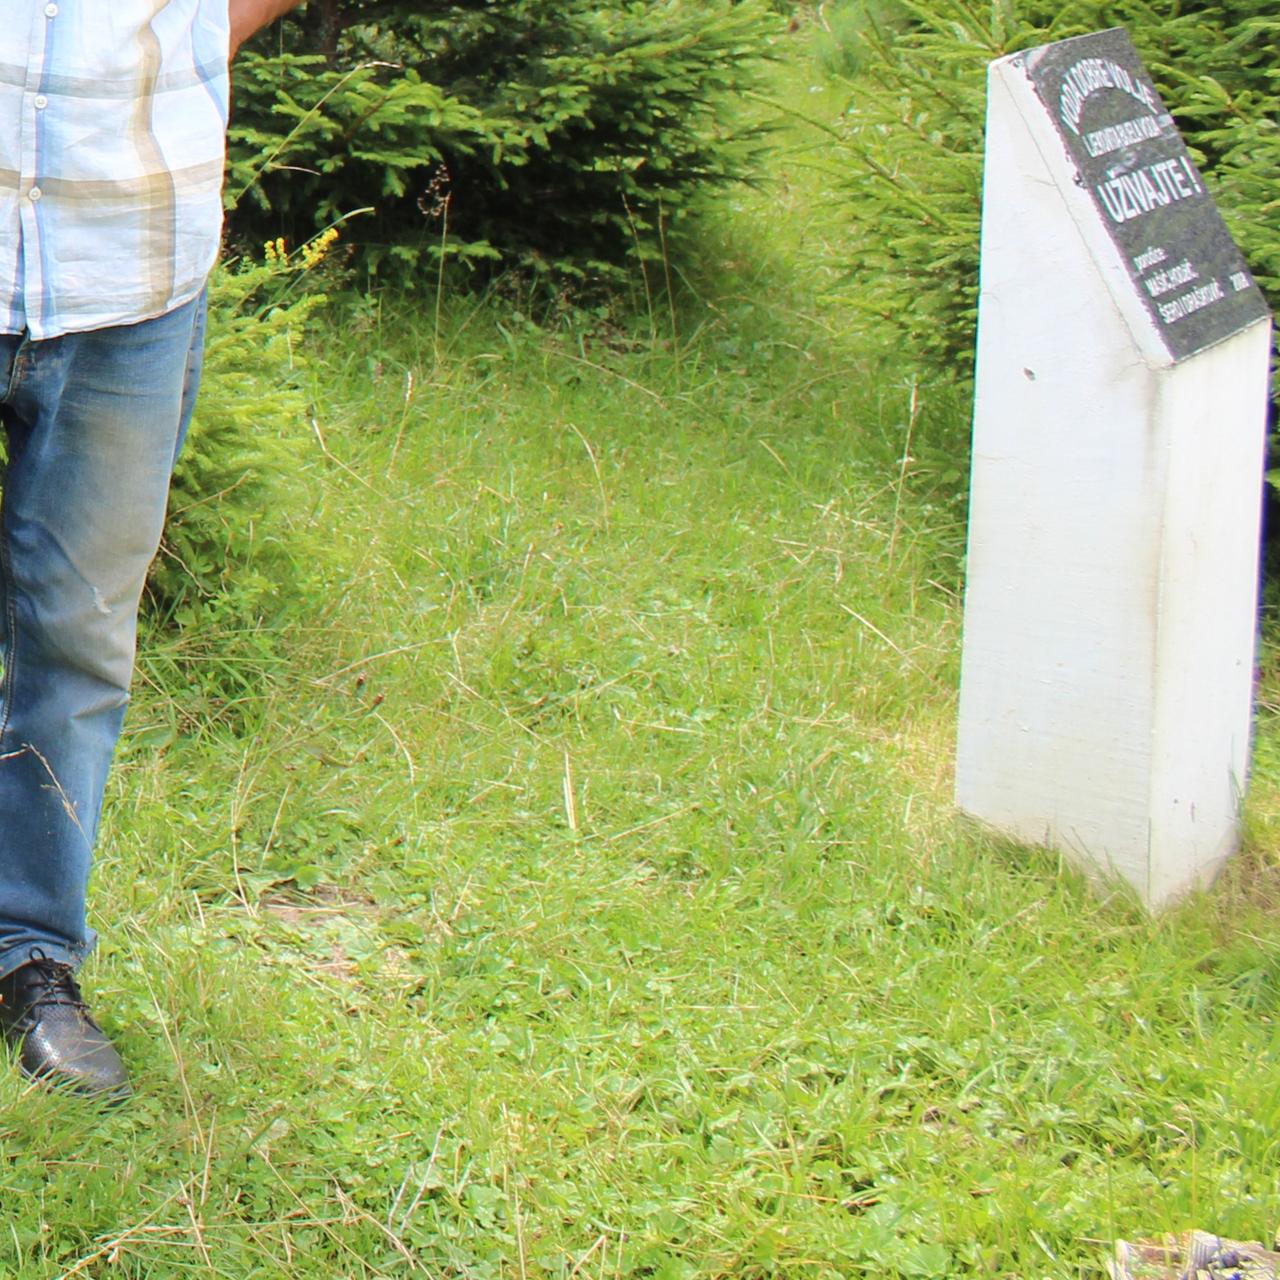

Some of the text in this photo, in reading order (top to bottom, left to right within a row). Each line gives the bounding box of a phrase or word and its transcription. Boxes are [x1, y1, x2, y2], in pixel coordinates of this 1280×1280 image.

[1060, 58, 1158, 136] VODA DOBRE VOLJE
